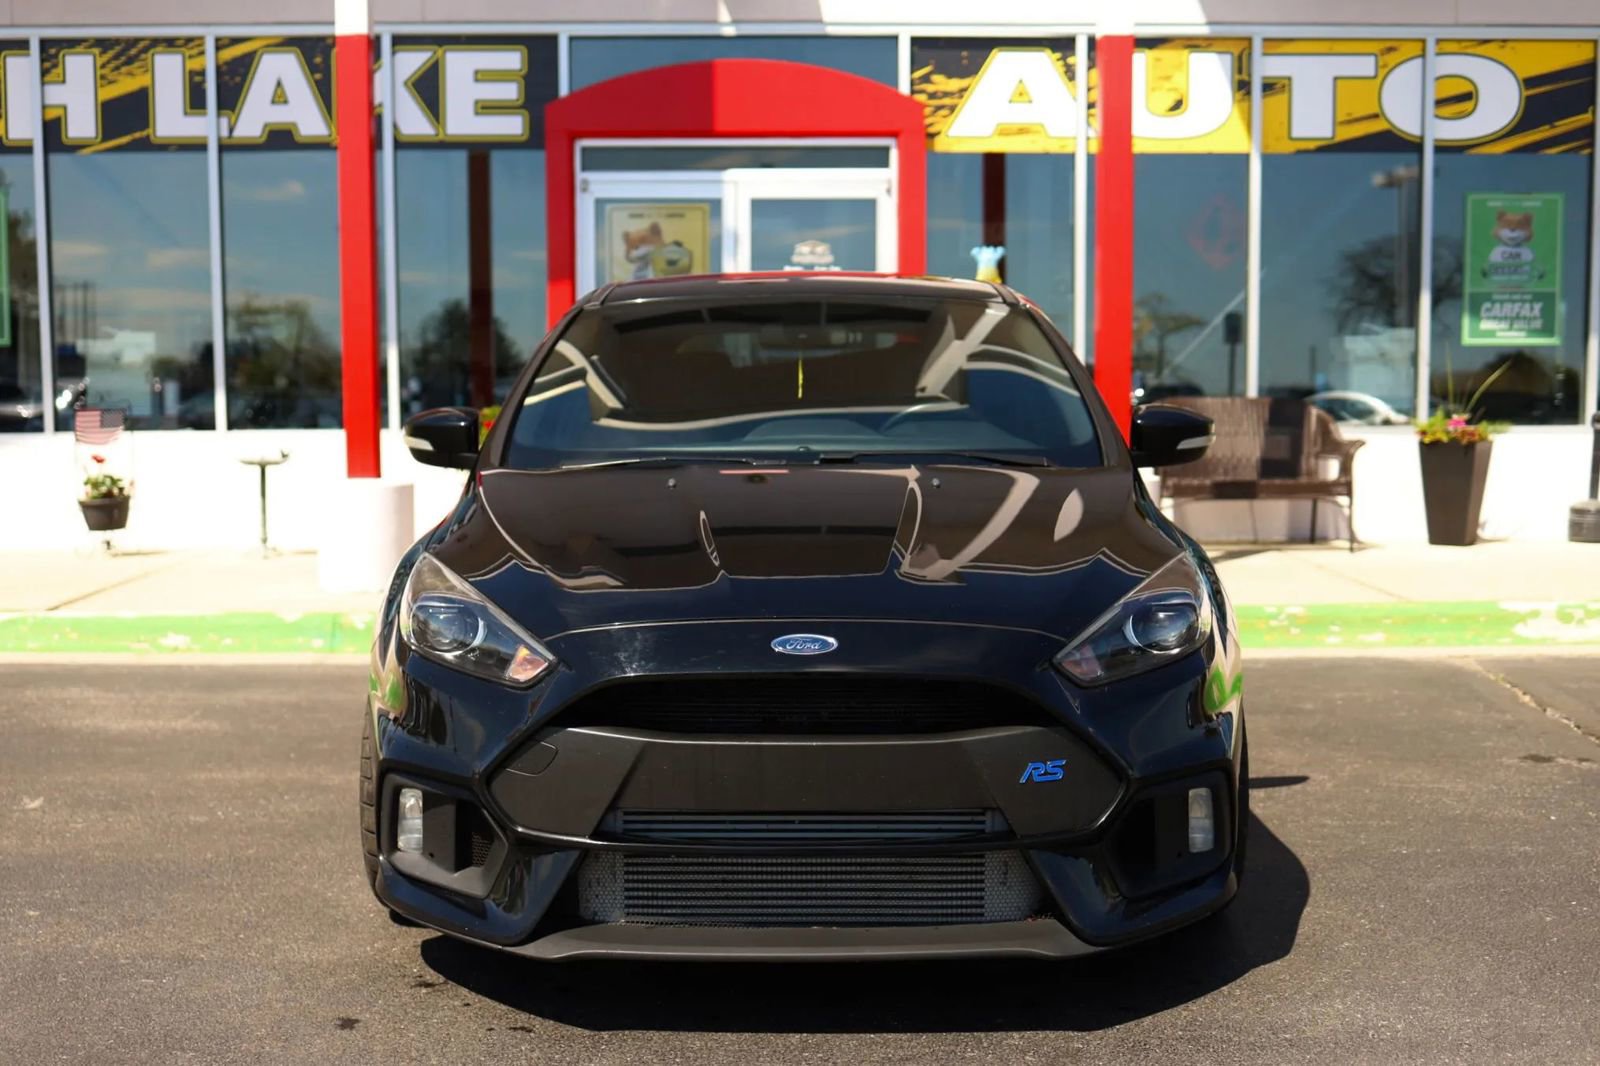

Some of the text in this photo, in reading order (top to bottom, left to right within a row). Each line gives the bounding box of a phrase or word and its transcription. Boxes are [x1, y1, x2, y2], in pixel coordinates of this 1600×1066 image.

[149, 48, 528, 143] LAKE
[944, 48, 1523, 143] AUTO
[1480, 302, 1543, 318] CARFAX
[1019, 759, 1067, 783] RS
